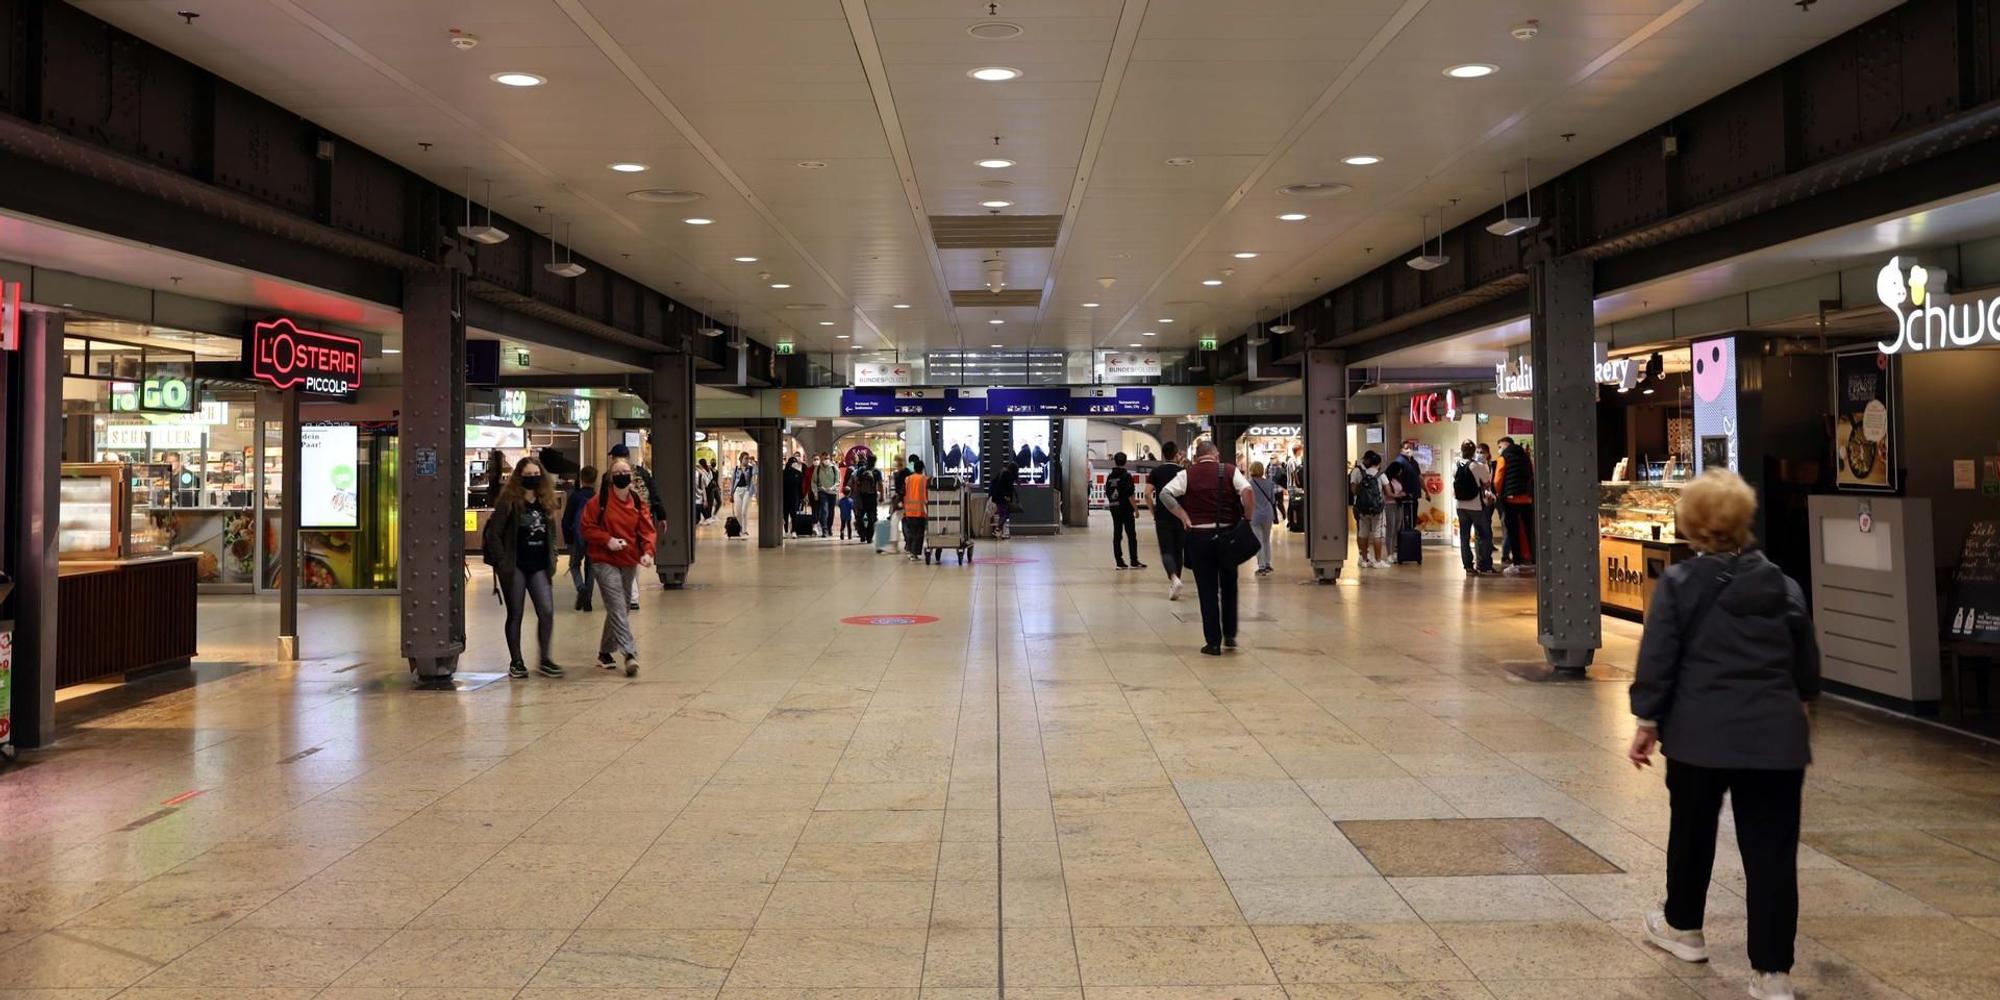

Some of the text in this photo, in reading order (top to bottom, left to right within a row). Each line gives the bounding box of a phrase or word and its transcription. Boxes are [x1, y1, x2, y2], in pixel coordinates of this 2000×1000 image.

[261, 334, 356, 374] L'OSTERIA
[144, 379, 188, 409] GO
[306, 377, 348, 394] PICCOLA
[1410, 393, 1438, 423] KFC
[1249, 426, 1301, 437] orsay
